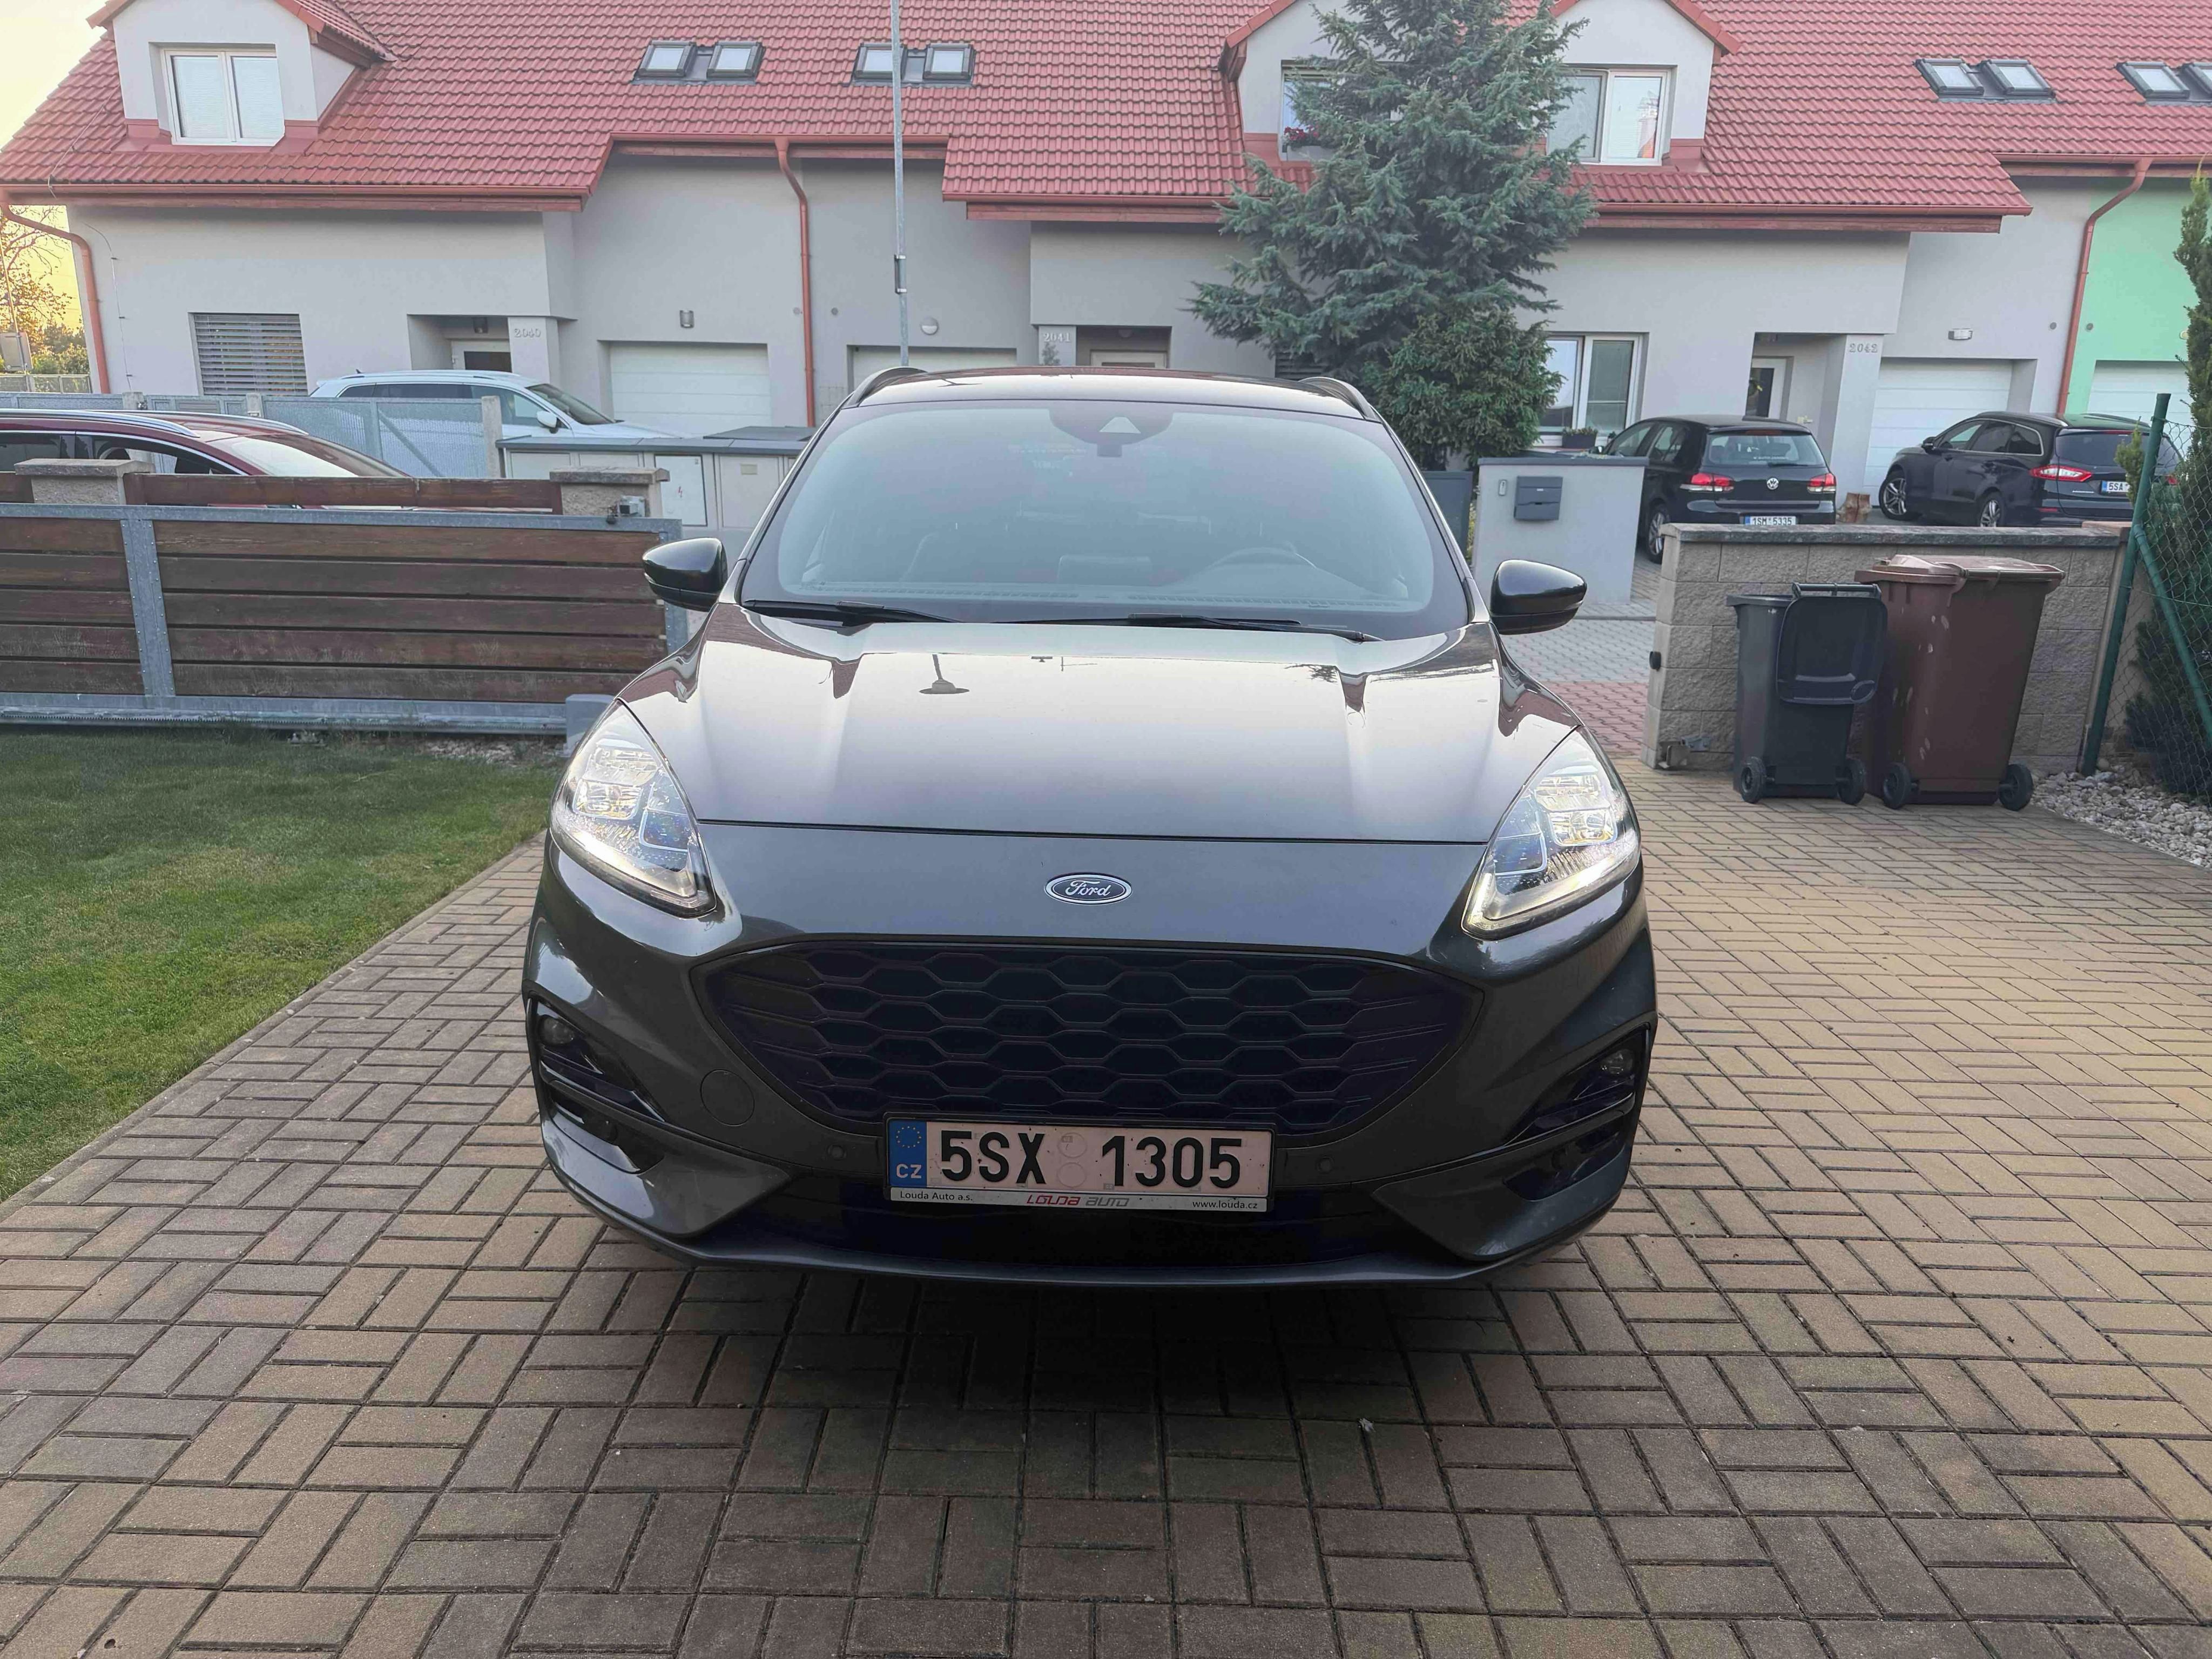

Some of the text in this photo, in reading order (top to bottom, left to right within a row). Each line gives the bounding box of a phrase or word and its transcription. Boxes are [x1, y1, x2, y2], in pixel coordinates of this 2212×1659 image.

[514, 328, 541, 338] 2040
[1043, 332, 1070, 342] 2041
[1849, 342, 1878, 353] 2042
[2108, 482, 2123, 491] 5SA
[1065, 880, 1112, 896] Ford
[940, 1129, 1242, 1189] 5SX 1305
[896, 1163, 922, 1179] CZ
[900, 1191, 929, 1199] Louda
[932, 1192, 955, 1201] Auto
[1192, 1200, 1258, 1209] www.louda.cz
